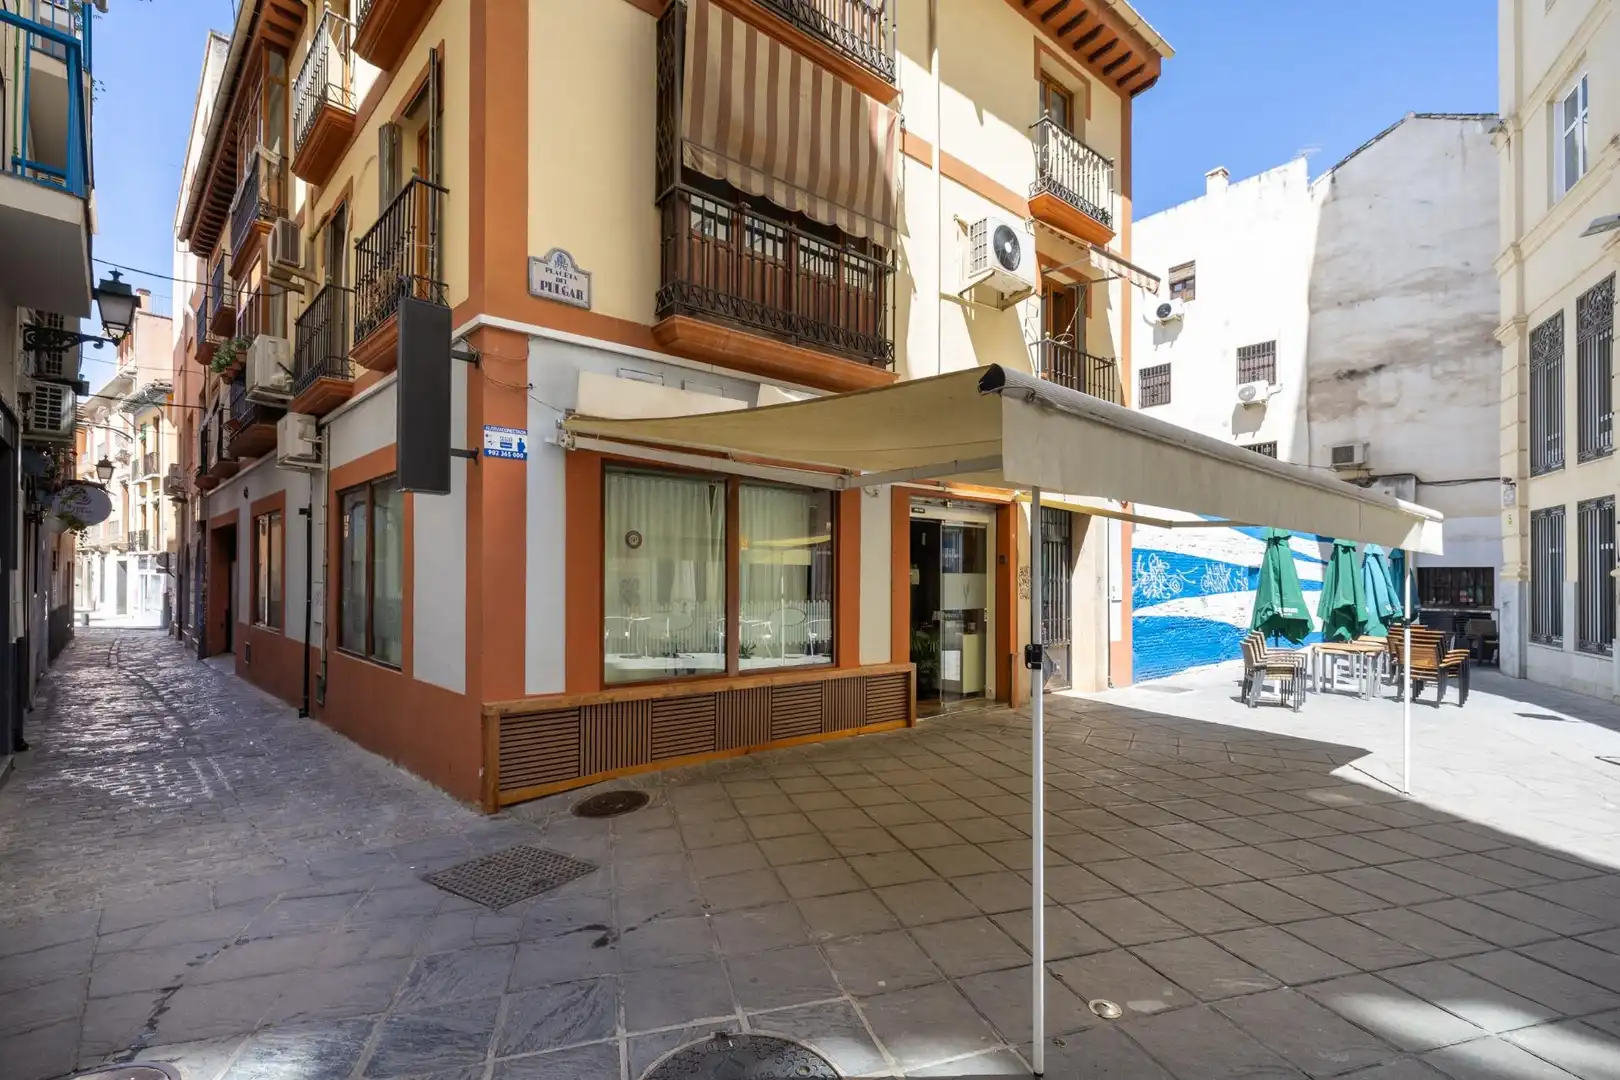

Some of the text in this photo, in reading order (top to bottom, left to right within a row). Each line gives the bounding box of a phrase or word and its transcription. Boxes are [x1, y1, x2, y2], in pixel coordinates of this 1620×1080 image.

[545, 267, 578, 281] PLACETA
[555, 277, 568, 285] DEL
[540, 280, 584, 301] PULGAR
